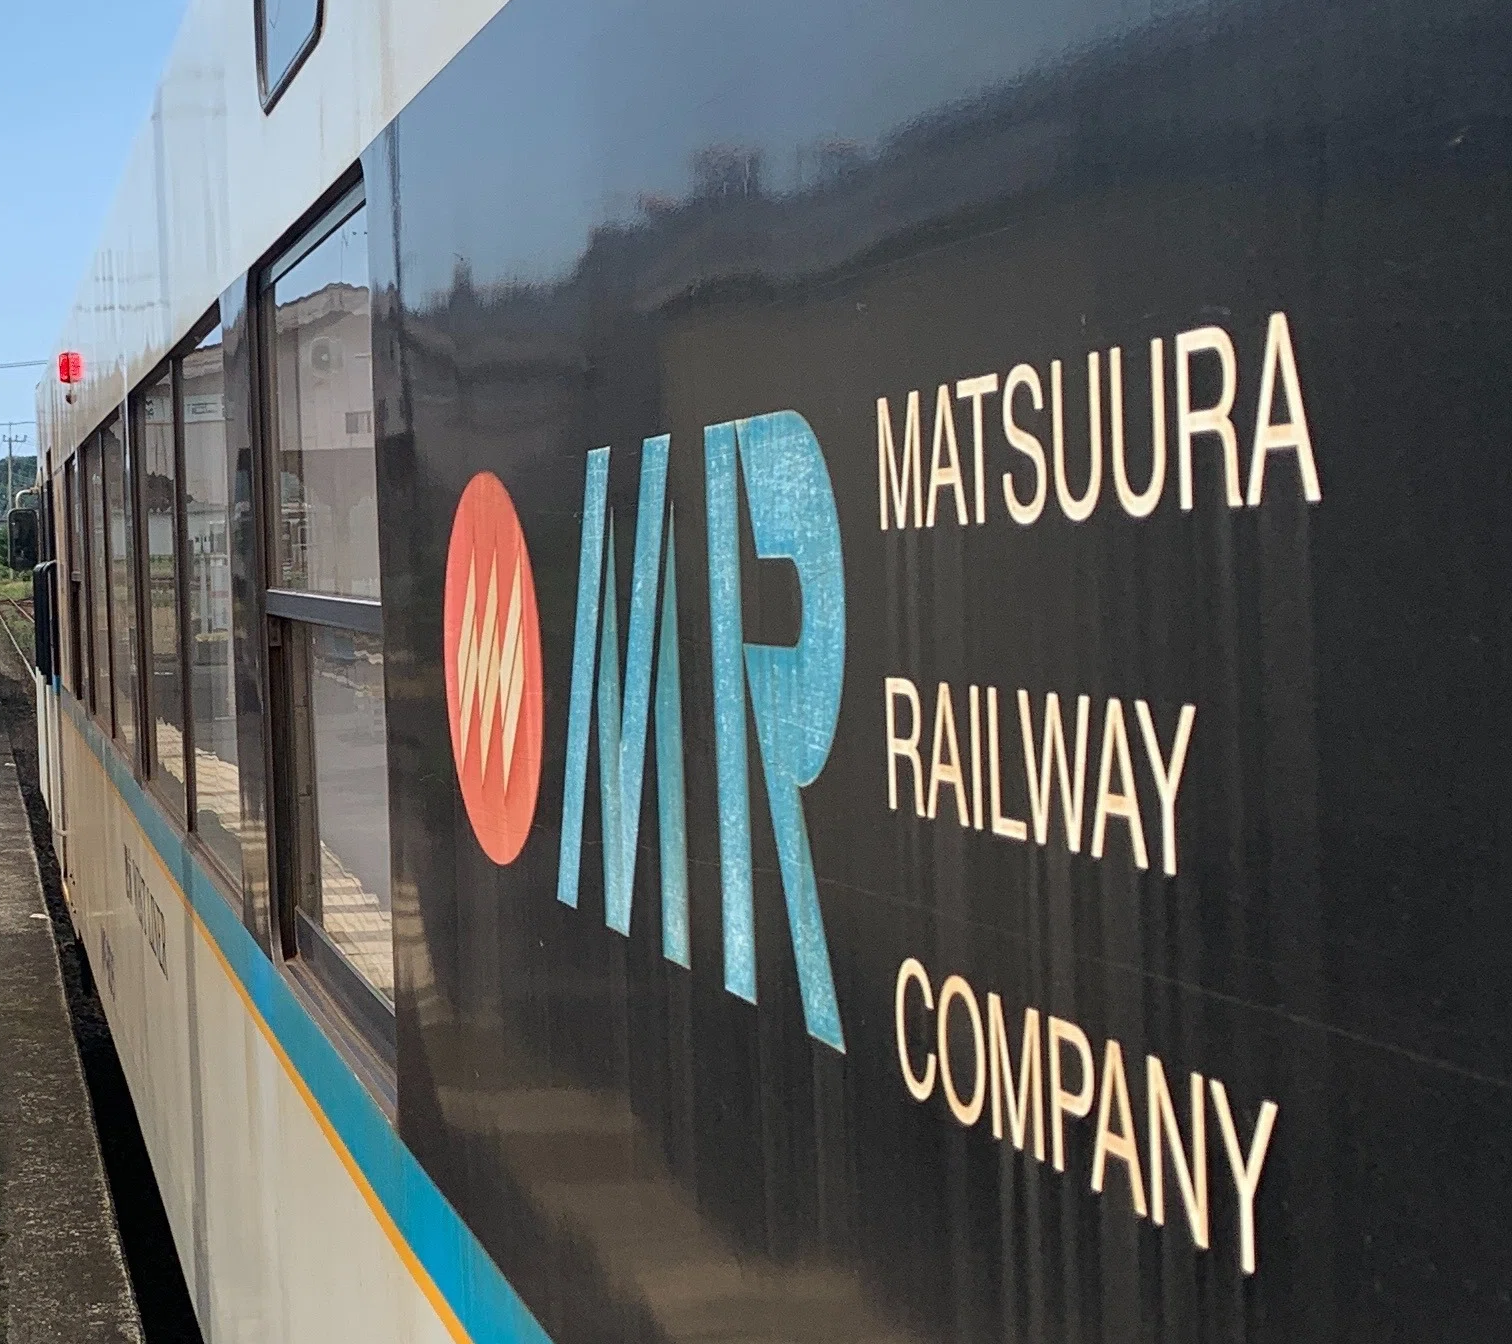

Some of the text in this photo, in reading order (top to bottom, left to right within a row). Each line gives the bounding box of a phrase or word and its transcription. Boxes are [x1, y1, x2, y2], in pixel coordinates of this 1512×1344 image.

[876, 310, 1323, 533] MATSUURA
[556, 408, 848, 1055] MR
[884, 674, 1198, 877] RAILWAY
[892, 955, 1280, 1277] COMPANY
